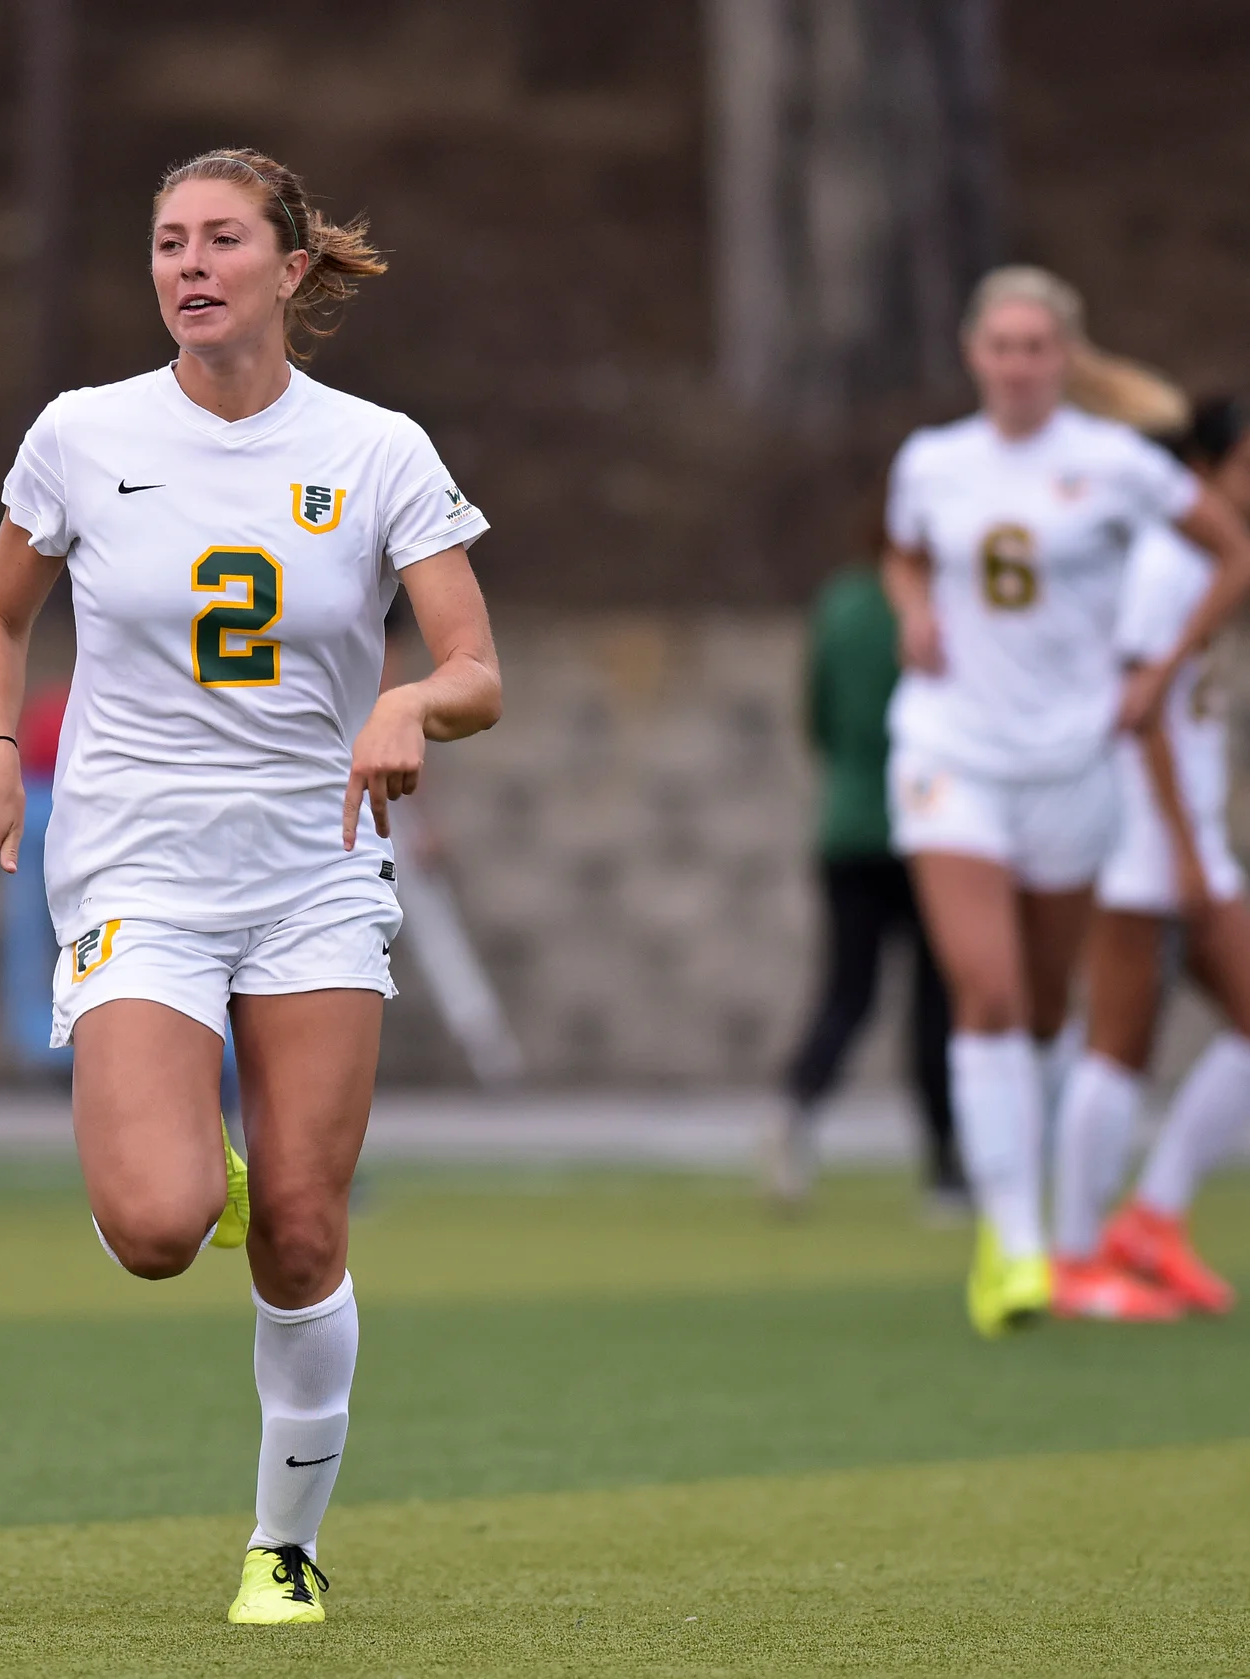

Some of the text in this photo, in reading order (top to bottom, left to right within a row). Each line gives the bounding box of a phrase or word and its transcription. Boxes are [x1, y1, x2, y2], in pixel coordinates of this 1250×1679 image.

[446, 508, 463, 520] WEST
[980, 522, 1040, 612] 6
[190, 545, 283, 688] 2
